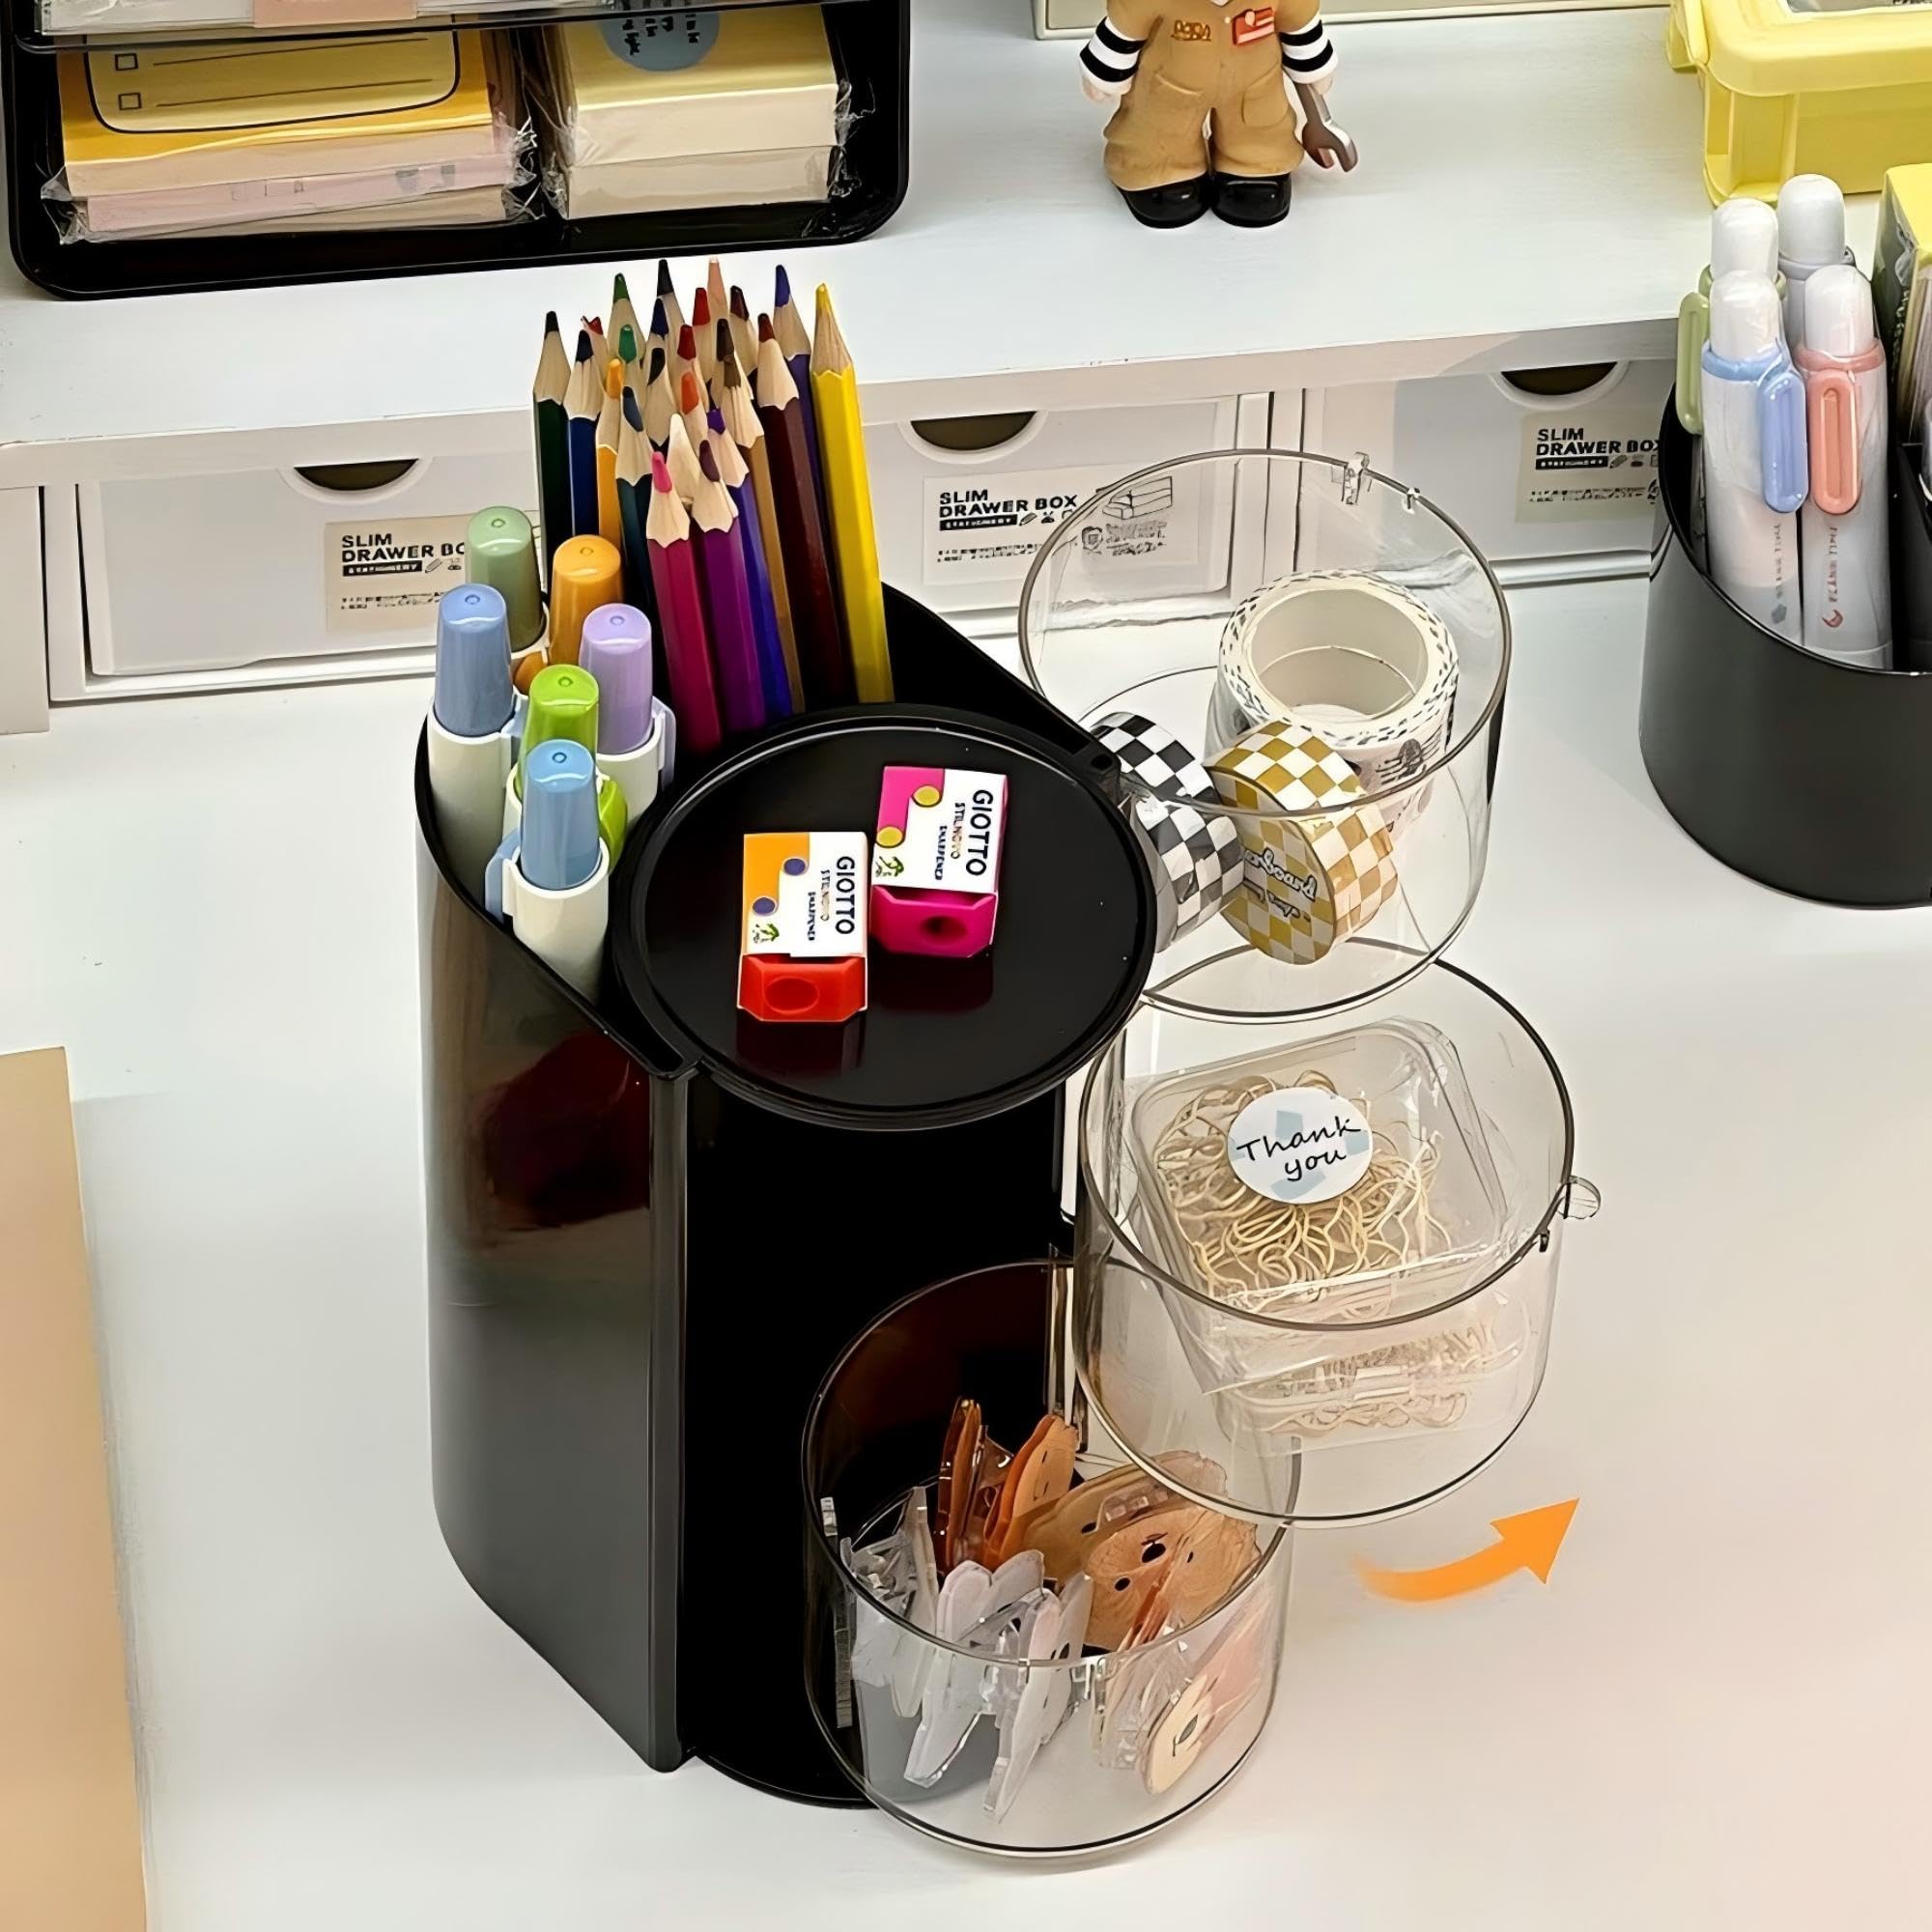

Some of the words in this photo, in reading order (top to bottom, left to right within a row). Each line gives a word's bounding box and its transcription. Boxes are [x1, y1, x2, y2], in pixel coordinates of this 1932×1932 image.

[1537, 428, 1584, 441] SLIM
[1535, 440, 1622, 456] DRAWER
[939, 489, 988, 504] SLIM
[939, 499, 1029, 518] DRAWER
[1035, 494, 1078, 510] BOX
[341, 533, 392, 548] SLIM
[341, 544, 434, 562] DRAWER
[966, 789, 994, 876] GIOTTO
[835, 856, 856, 935] GIOTTO
[1236, 1116, 1362, 1161] Thank
[1284, 1150, 1347, 1182] you
